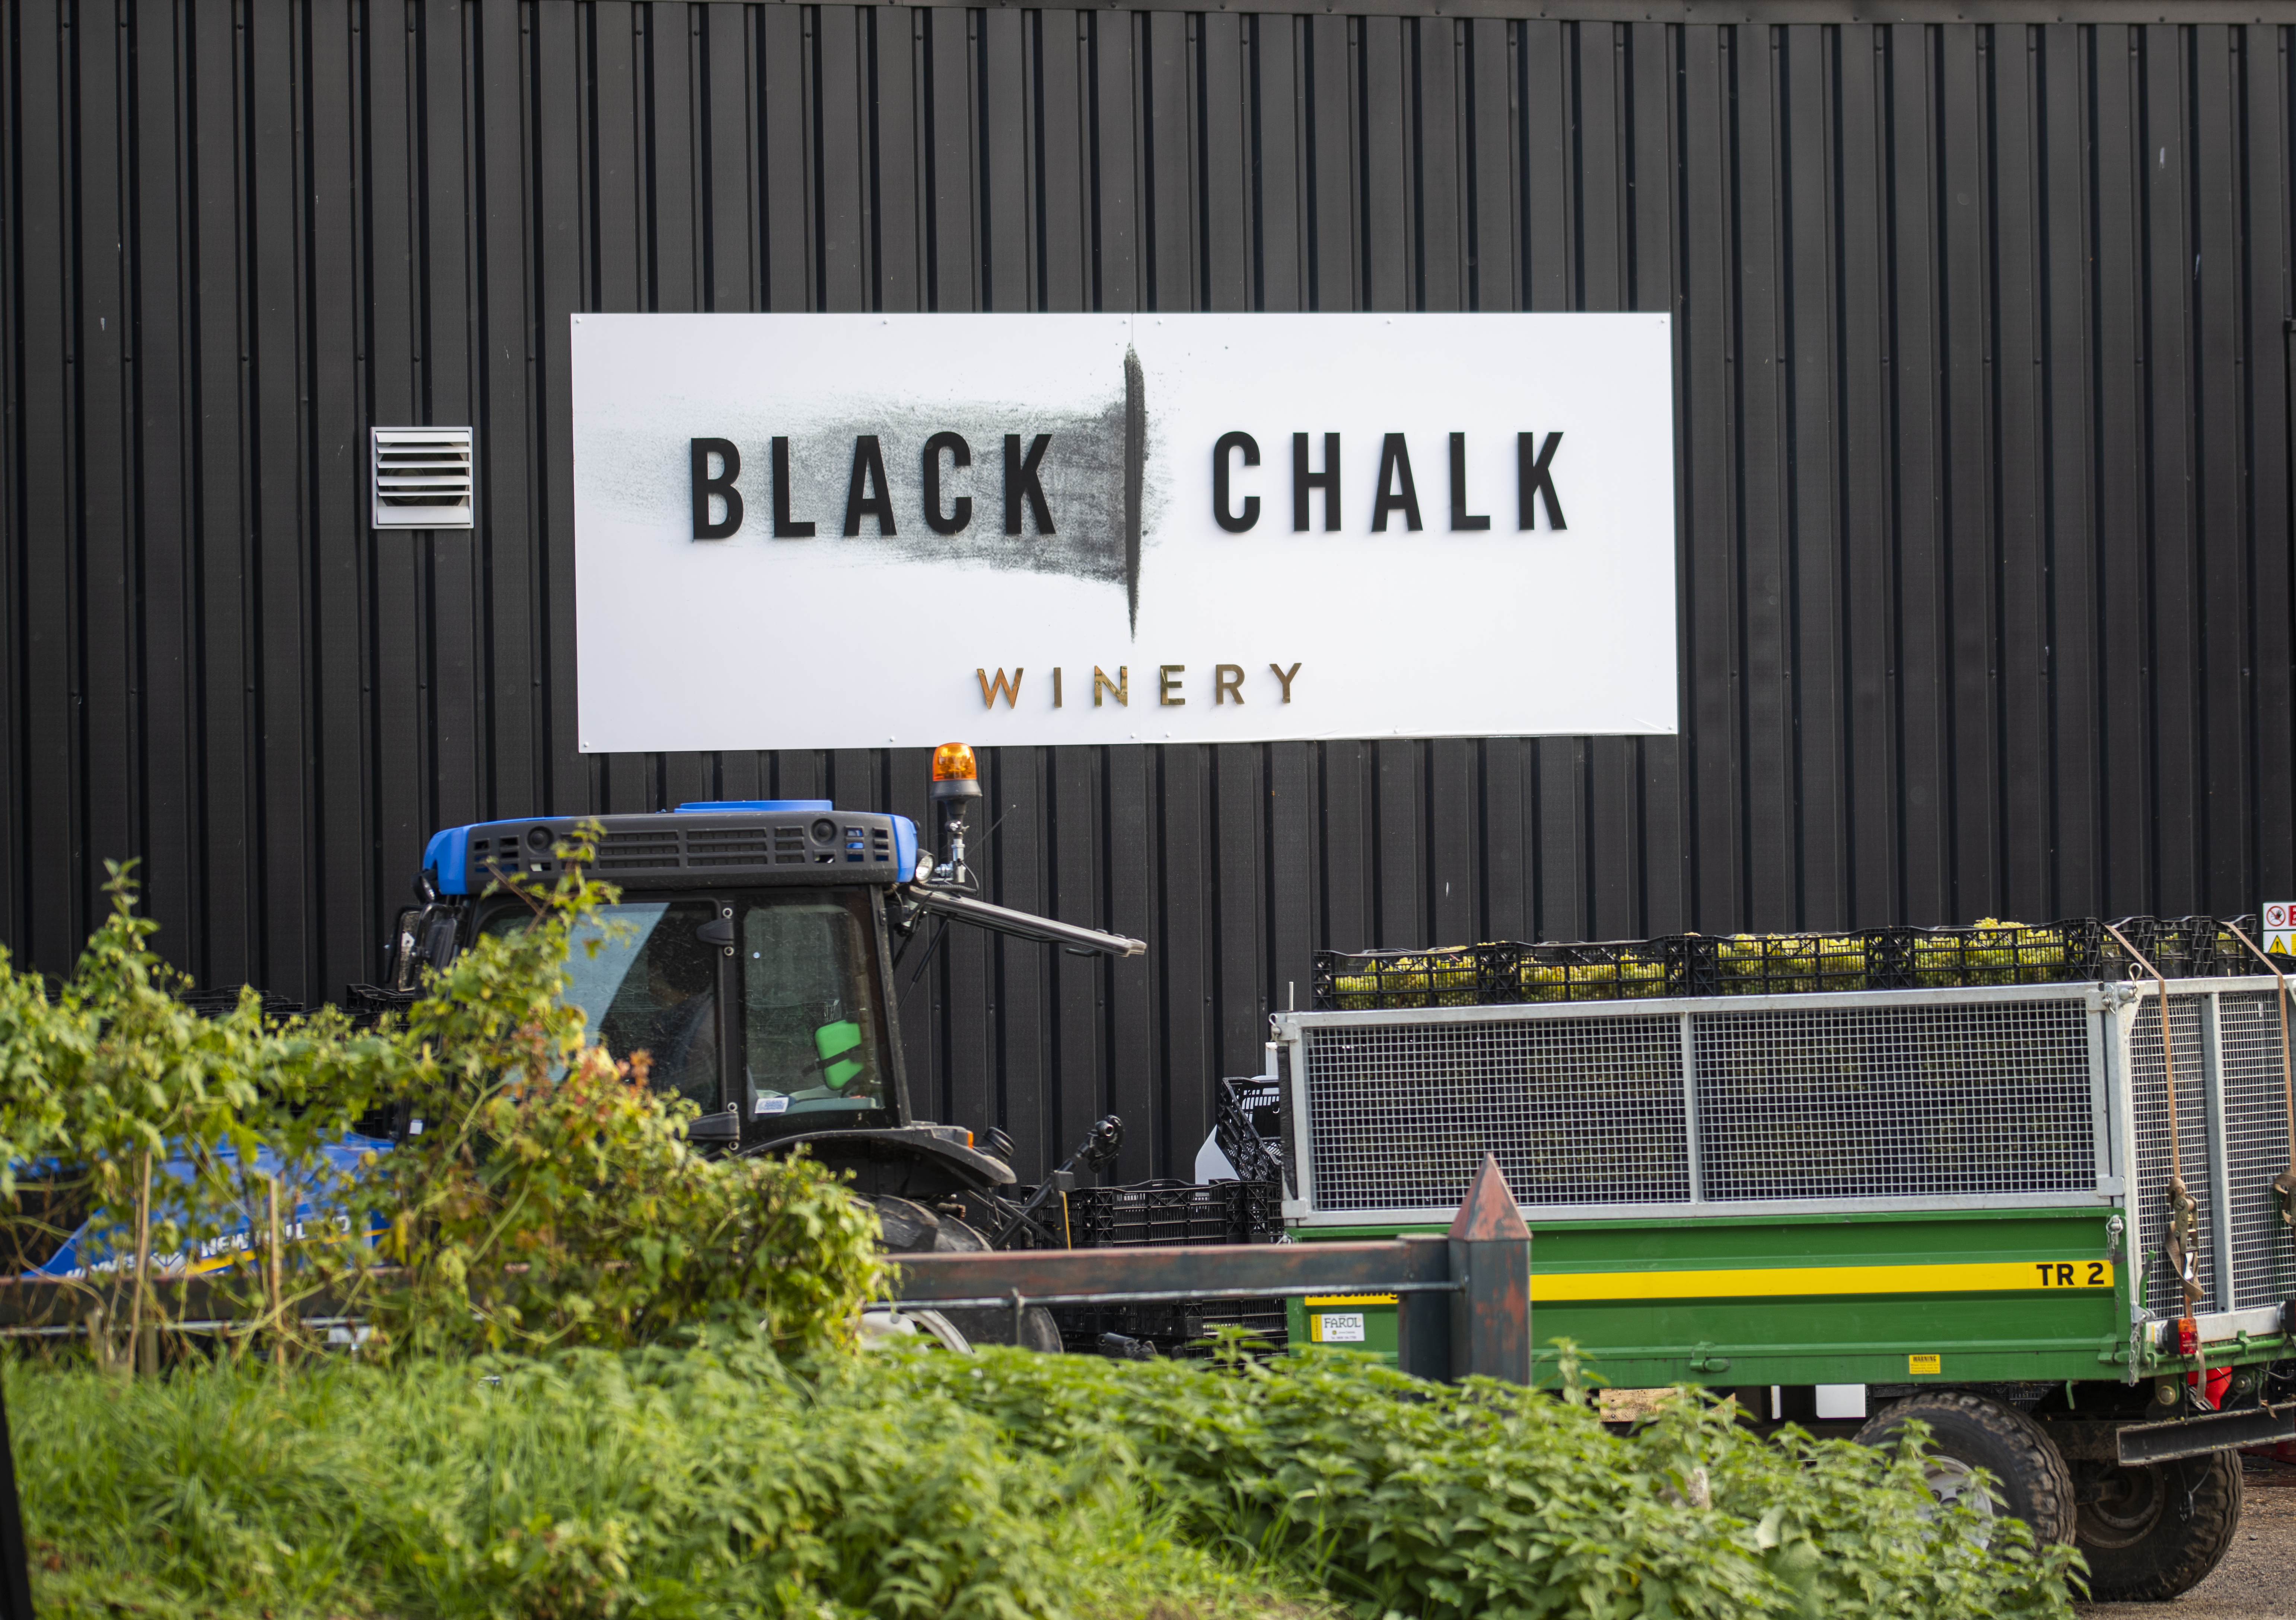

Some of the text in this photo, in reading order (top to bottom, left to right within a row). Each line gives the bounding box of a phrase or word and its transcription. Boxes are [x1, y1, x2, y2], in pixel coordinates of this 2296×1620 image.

[691, 431, 1567, 539] BLACK CHALK
[977, 663, 1302, 709] WINERY
[201, 1232, 250, 1257] NEW
[2036, 1262, 2104, 1286] TR 2
[1324, 1317, 1361, 1328] FAROL
